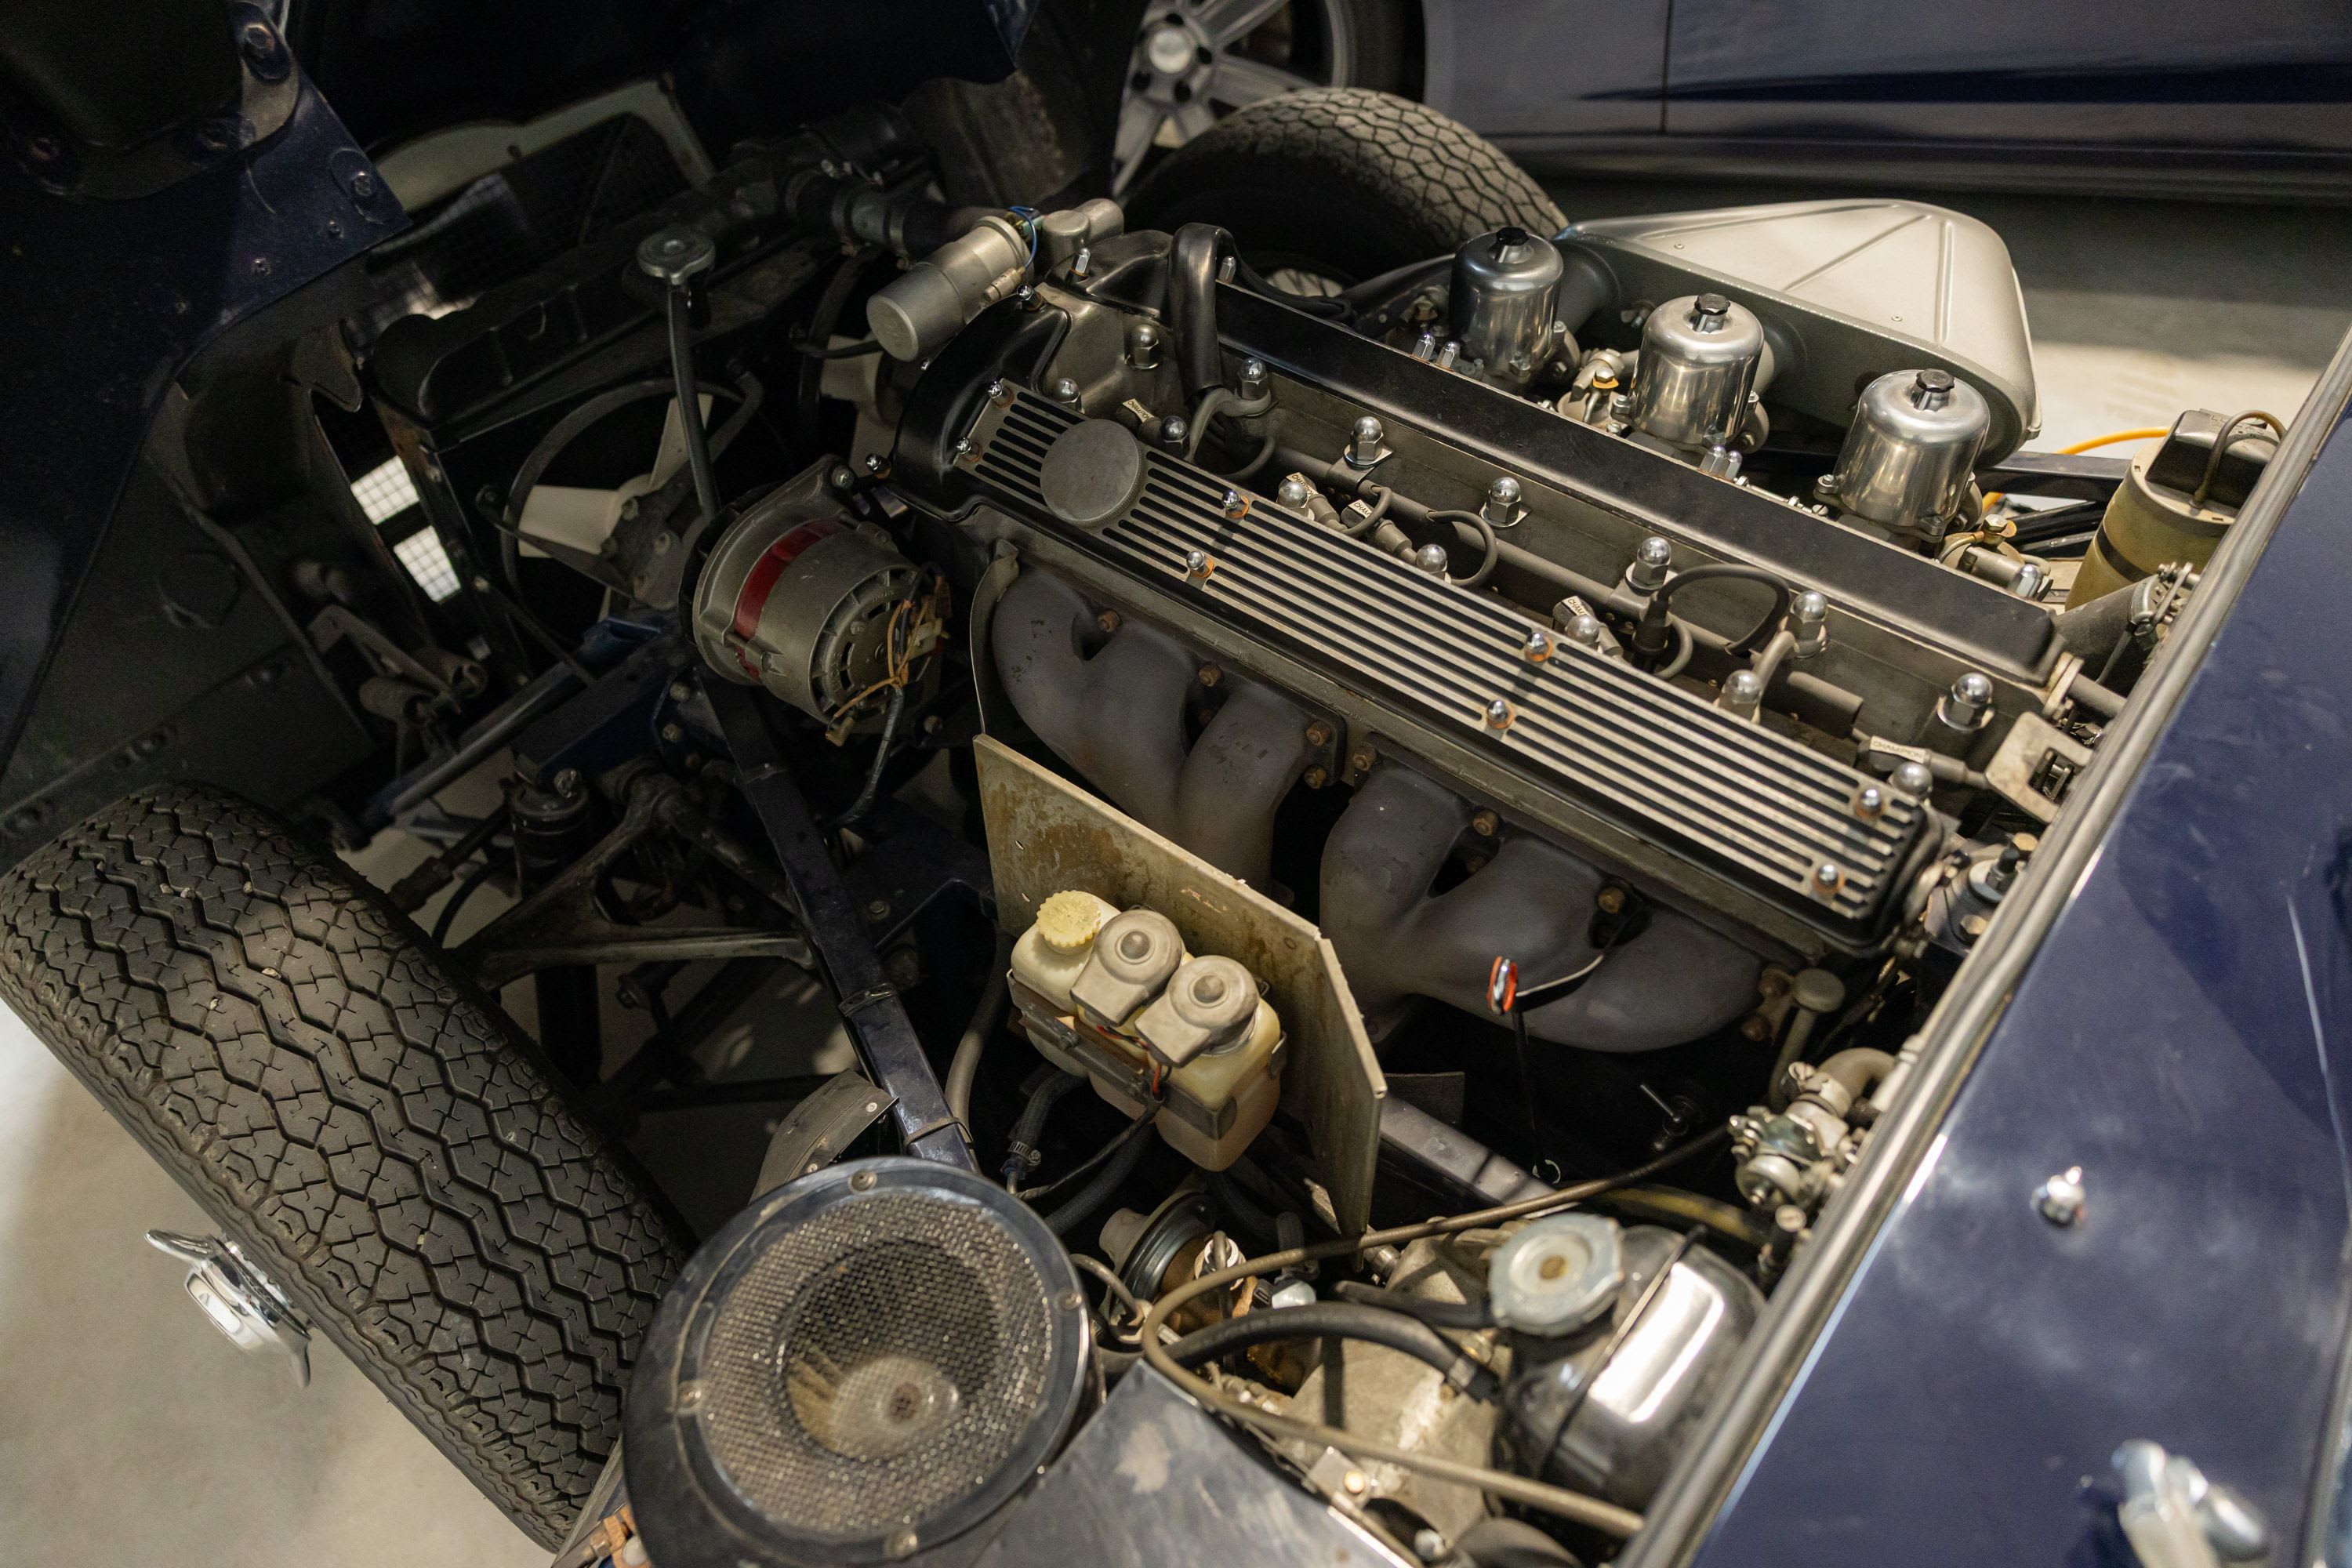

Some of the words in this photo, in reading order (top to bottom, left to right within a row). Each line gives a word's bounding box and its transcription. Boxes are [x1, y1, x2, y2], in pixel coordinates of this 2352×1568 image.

[1354, 503, 1370, 515] CHAM
[1568, 598, 1585, 615] CHAM
[1874, 741, 1922, 758] CHAMPION
